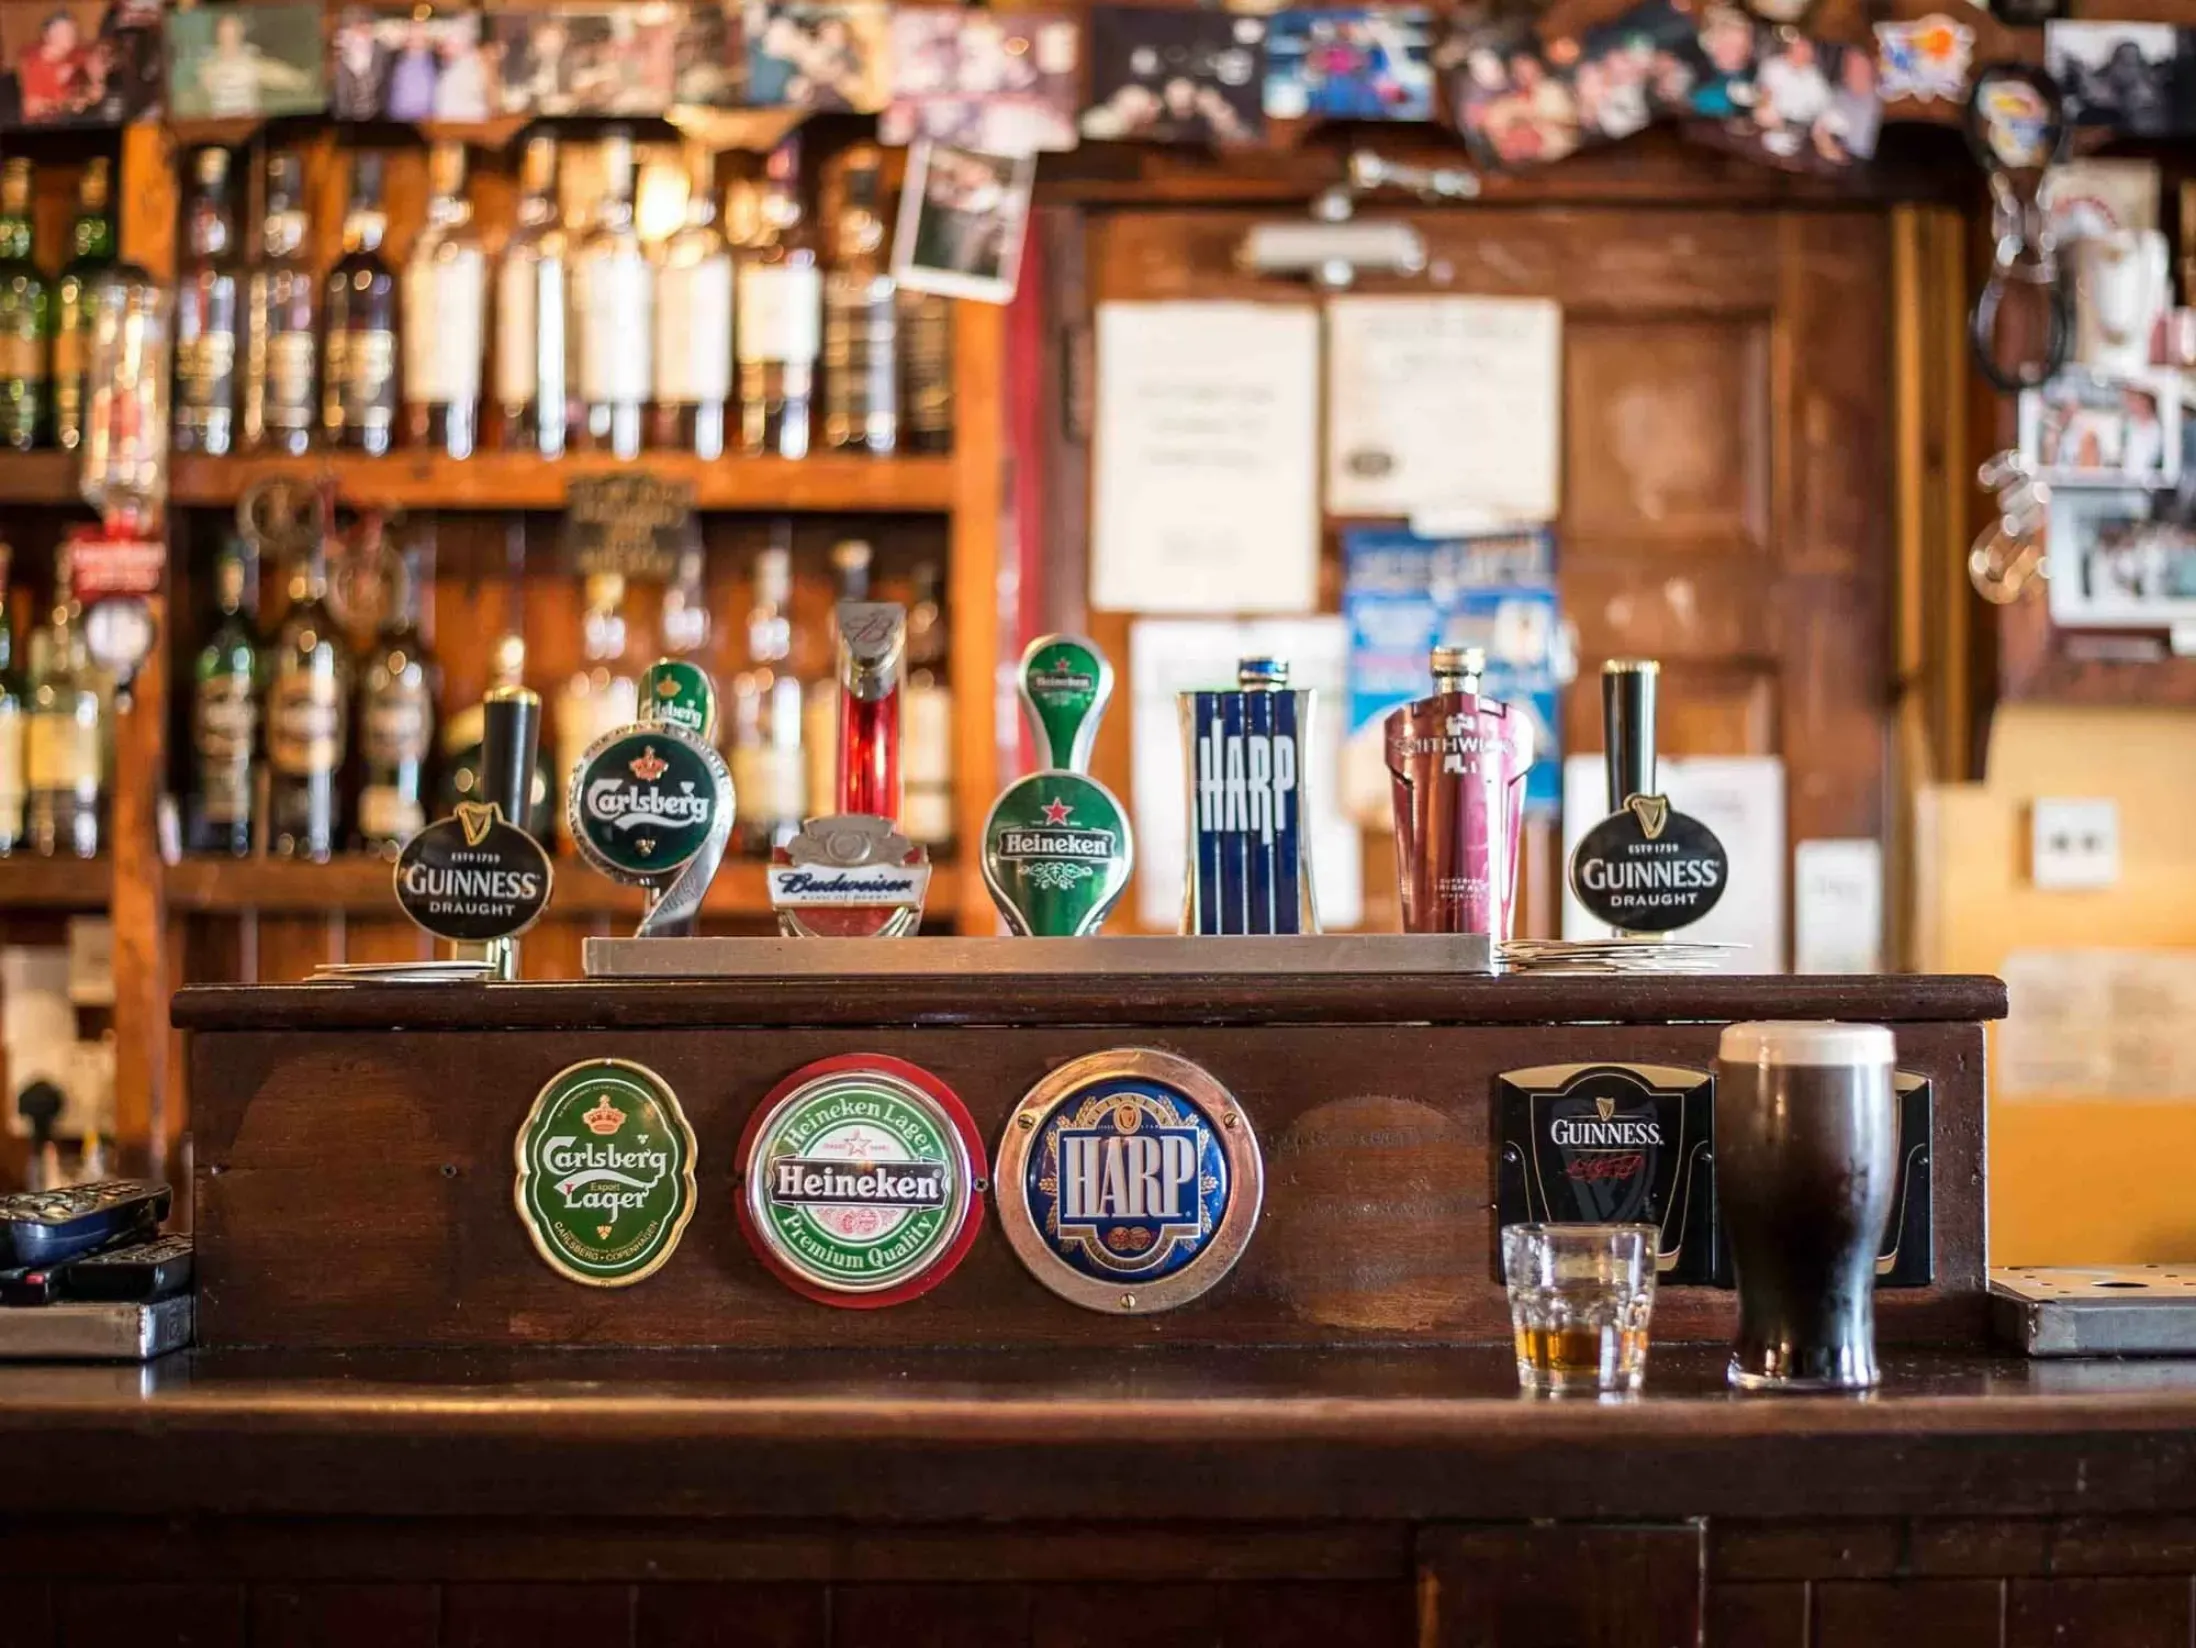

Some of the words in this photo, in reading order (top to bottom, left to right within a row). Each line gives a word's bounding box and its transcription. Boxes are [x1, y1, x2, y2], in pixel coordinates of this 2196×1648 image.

[1199, 718, 1296, 845] HARP
[586, 778, 711, 823] Carlsberg
[1005, 833, 1108, 856] Heineken
[405, 863, 538, 900] GUINNESS
[777, 871, 914, 894] Budweiser
[1582, 858, 1719, 890] GUINNESS
[429, 902, 516, 917] DRAUGHT
[1610, 893, 1698, 907] DRAUGHT
[783, 1098, 881, 1149] Heineken
[883, 1104, 935, 1154] Lager
[1550, 1119, 1661, 1145] GUINNESS
[542, 1136, 668, 1178] Carlsberg
[589, 1182, 621, 1193] Export
[777, 1165, 940, 1198] Heineken
[1063, 1135, 1197, 1218] HARP
[563, 1187, 650, 1224] Lager
[554, 1221, 600, 1262] CARLSBERG
[605, 1219, 660, 1262] COPENHAGEN
[782, 1213, 864, 1269] Premium
[867, 1216, 935, 1268] Quality
